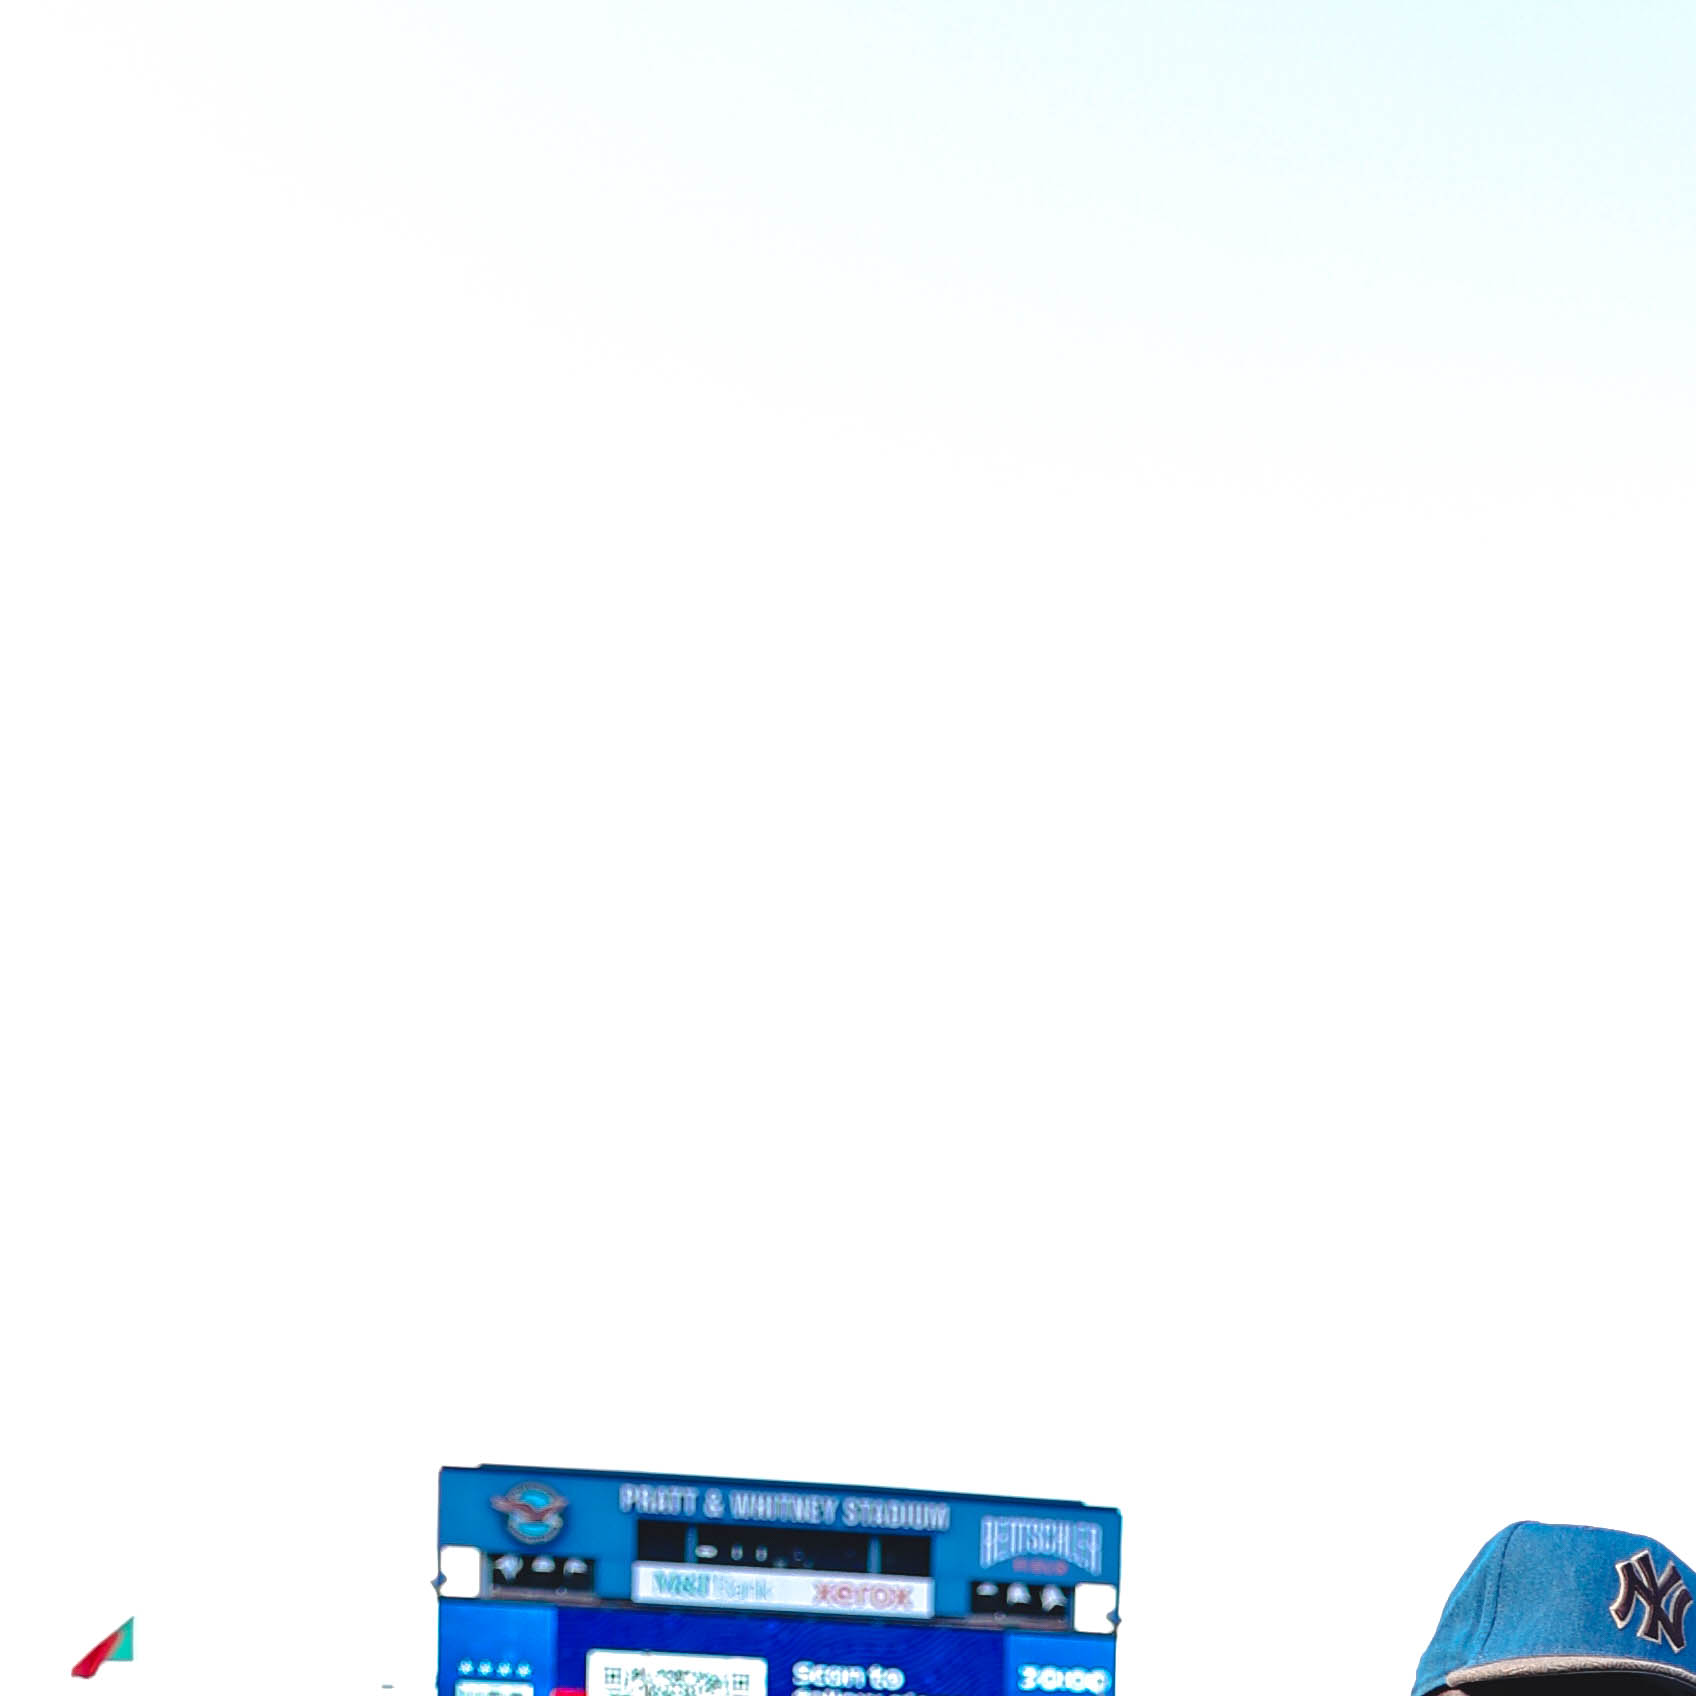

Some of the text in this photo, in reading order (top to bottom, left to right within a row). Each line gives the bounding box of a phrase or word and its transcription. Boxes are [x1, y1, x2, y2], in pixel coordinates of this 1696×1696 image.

[620, 1484, 951, 1531] PRATT & WHITNEY STADIUM
[792, 1661, 905, 1691] Scan to
